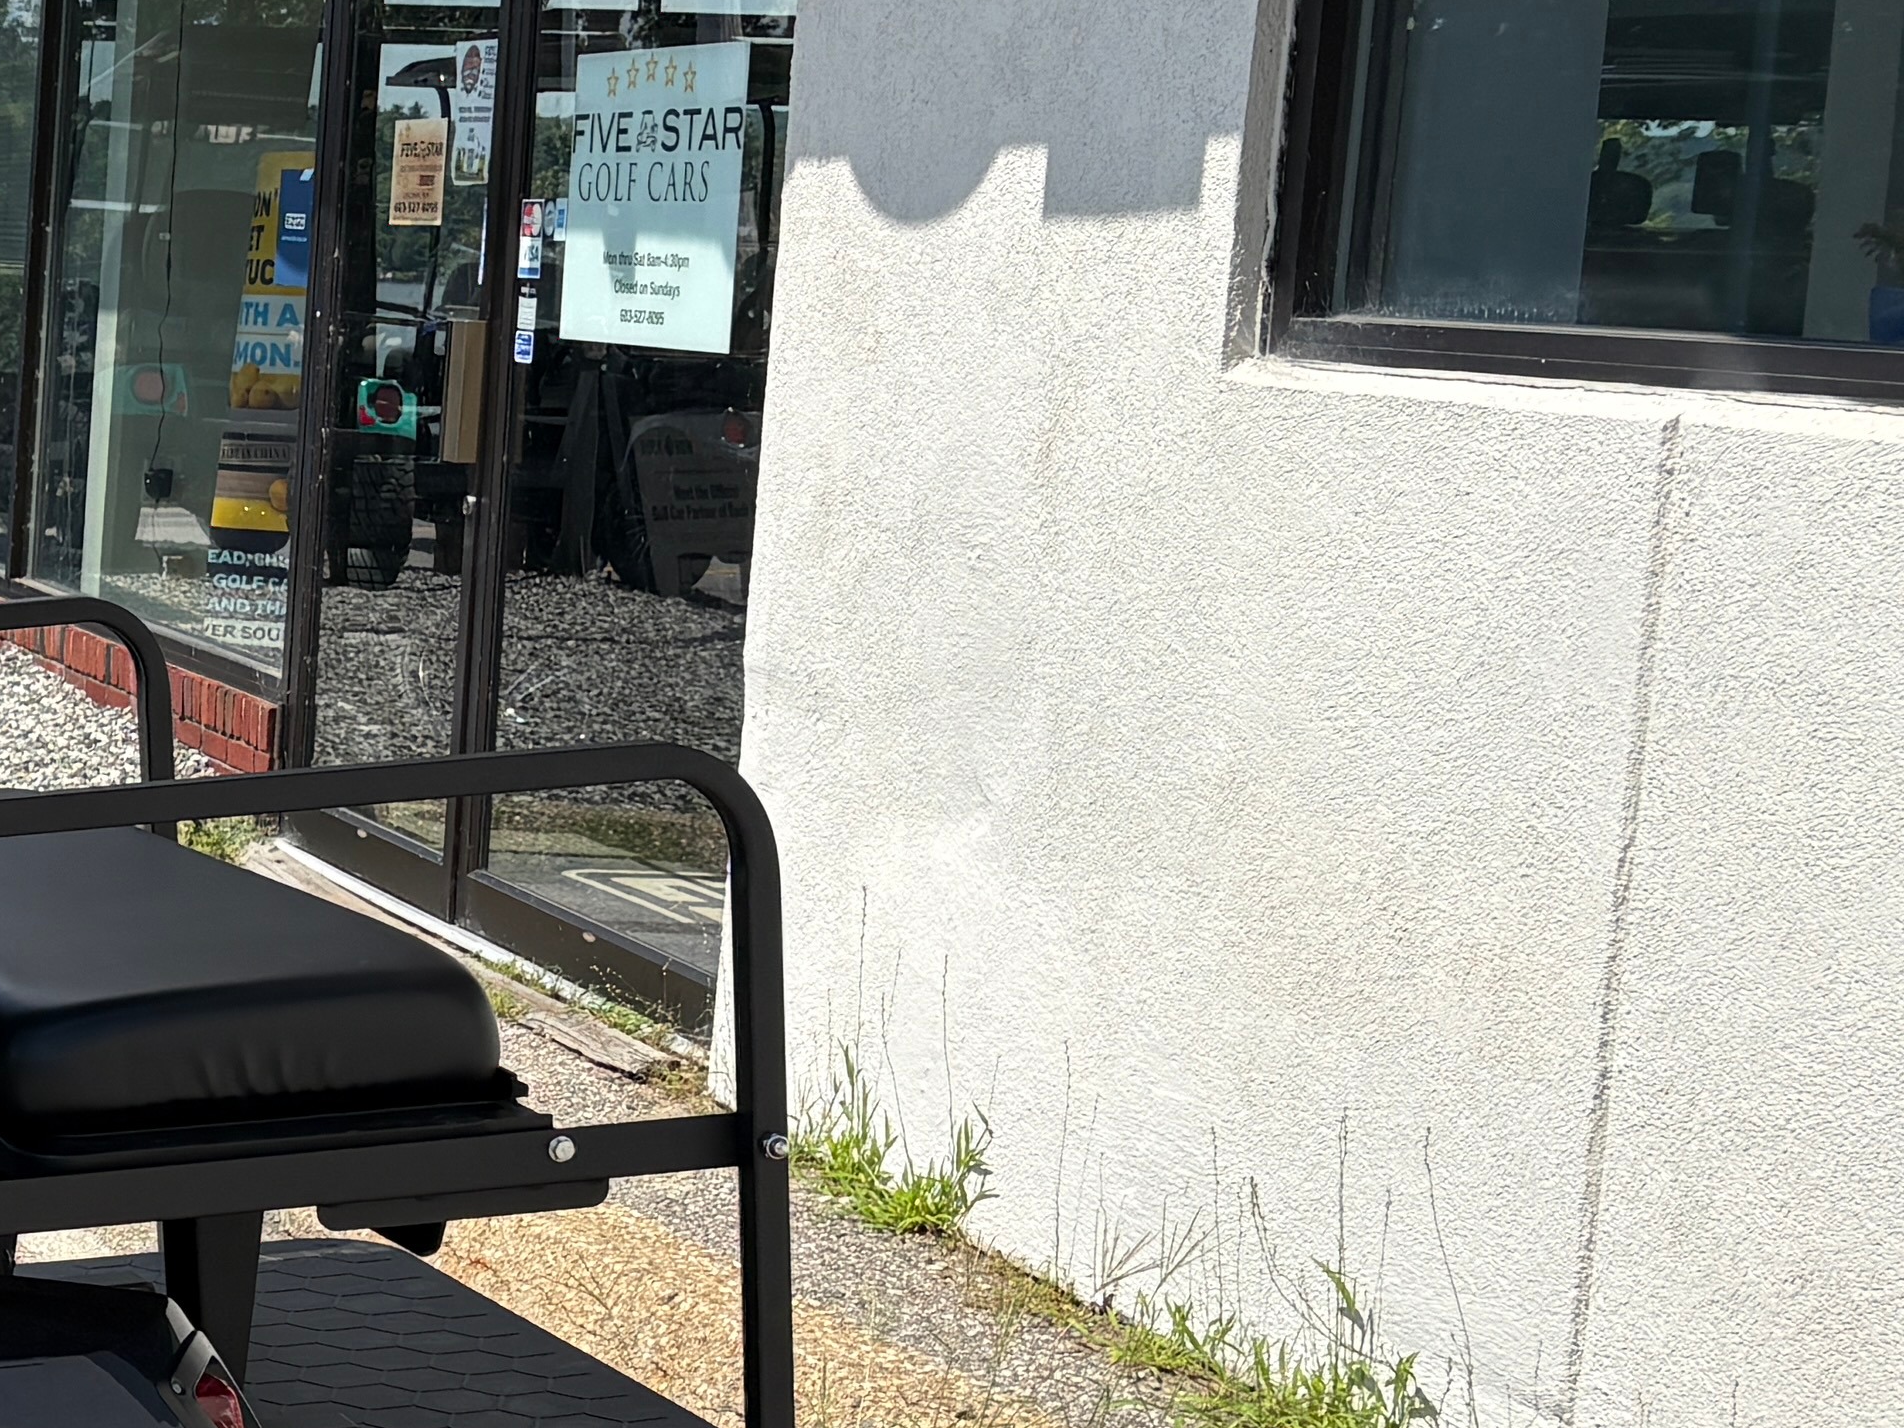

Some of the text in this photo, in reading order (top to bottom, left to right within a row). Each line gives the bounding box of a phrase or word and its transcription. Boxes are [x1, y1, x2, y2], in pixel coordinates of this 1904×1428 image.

[573, 106, 744, 154] FIVE STAR
[578, 160, 710, 203] GOLF CARS
[603, 251, 618, 265] Mon
[634, 252, 645, 266] Sat
[614, 278, 680, 300] Closed on Sundays
[276, 303, 300, 327] A
[213, 573, 265, 590] GOLF
